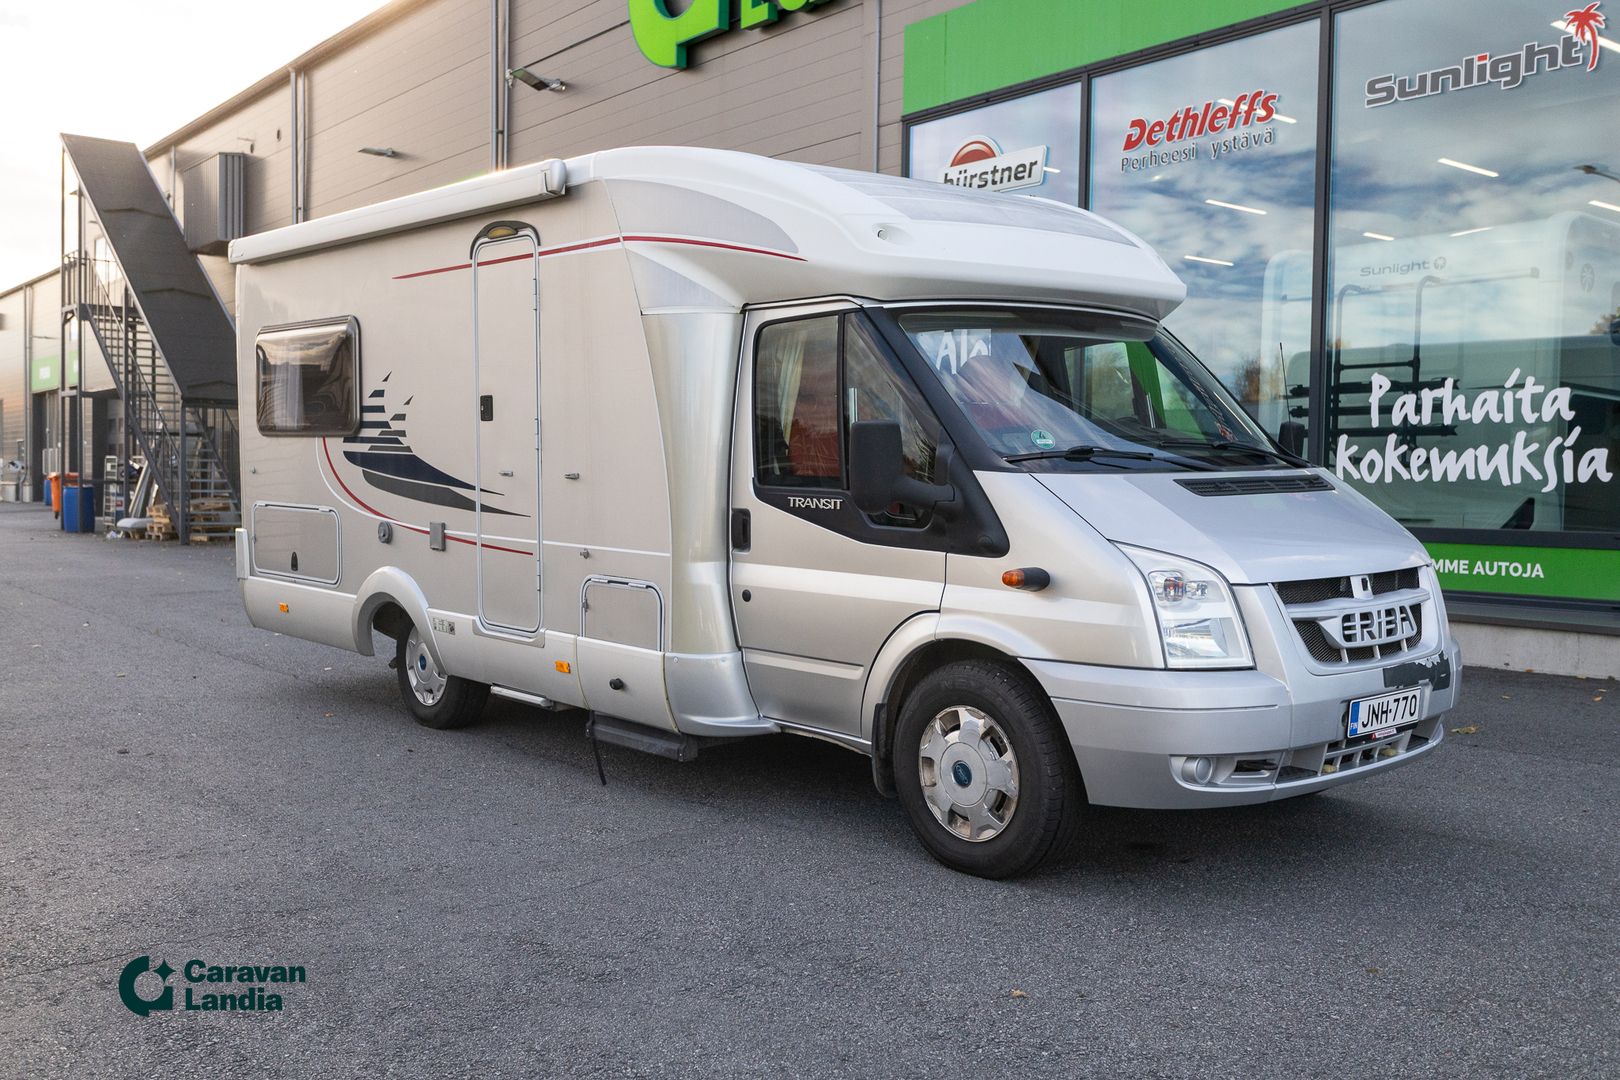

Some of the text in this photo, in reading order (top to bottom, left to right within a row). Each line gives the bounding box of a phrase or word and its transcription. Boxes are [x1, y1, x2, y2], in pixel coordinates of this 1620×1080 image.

[1365, 34, 1583, 108] Sunlight
[1122, 90, 1277, 151] Dethleffs
[1121, 127, 1274, 172] Perheesi ystävä
[1360, 260, 1430, 276] Sunlight
[1369, 367, 1576, 428] Parhaita
[788, 496, 843, 510] TRANSIT
[1472, 560, 1545, 579] AUTOJA
[1342, 605, 1416, 643] ERIBA
[1361, 694, 1418, 728] JNH-770
